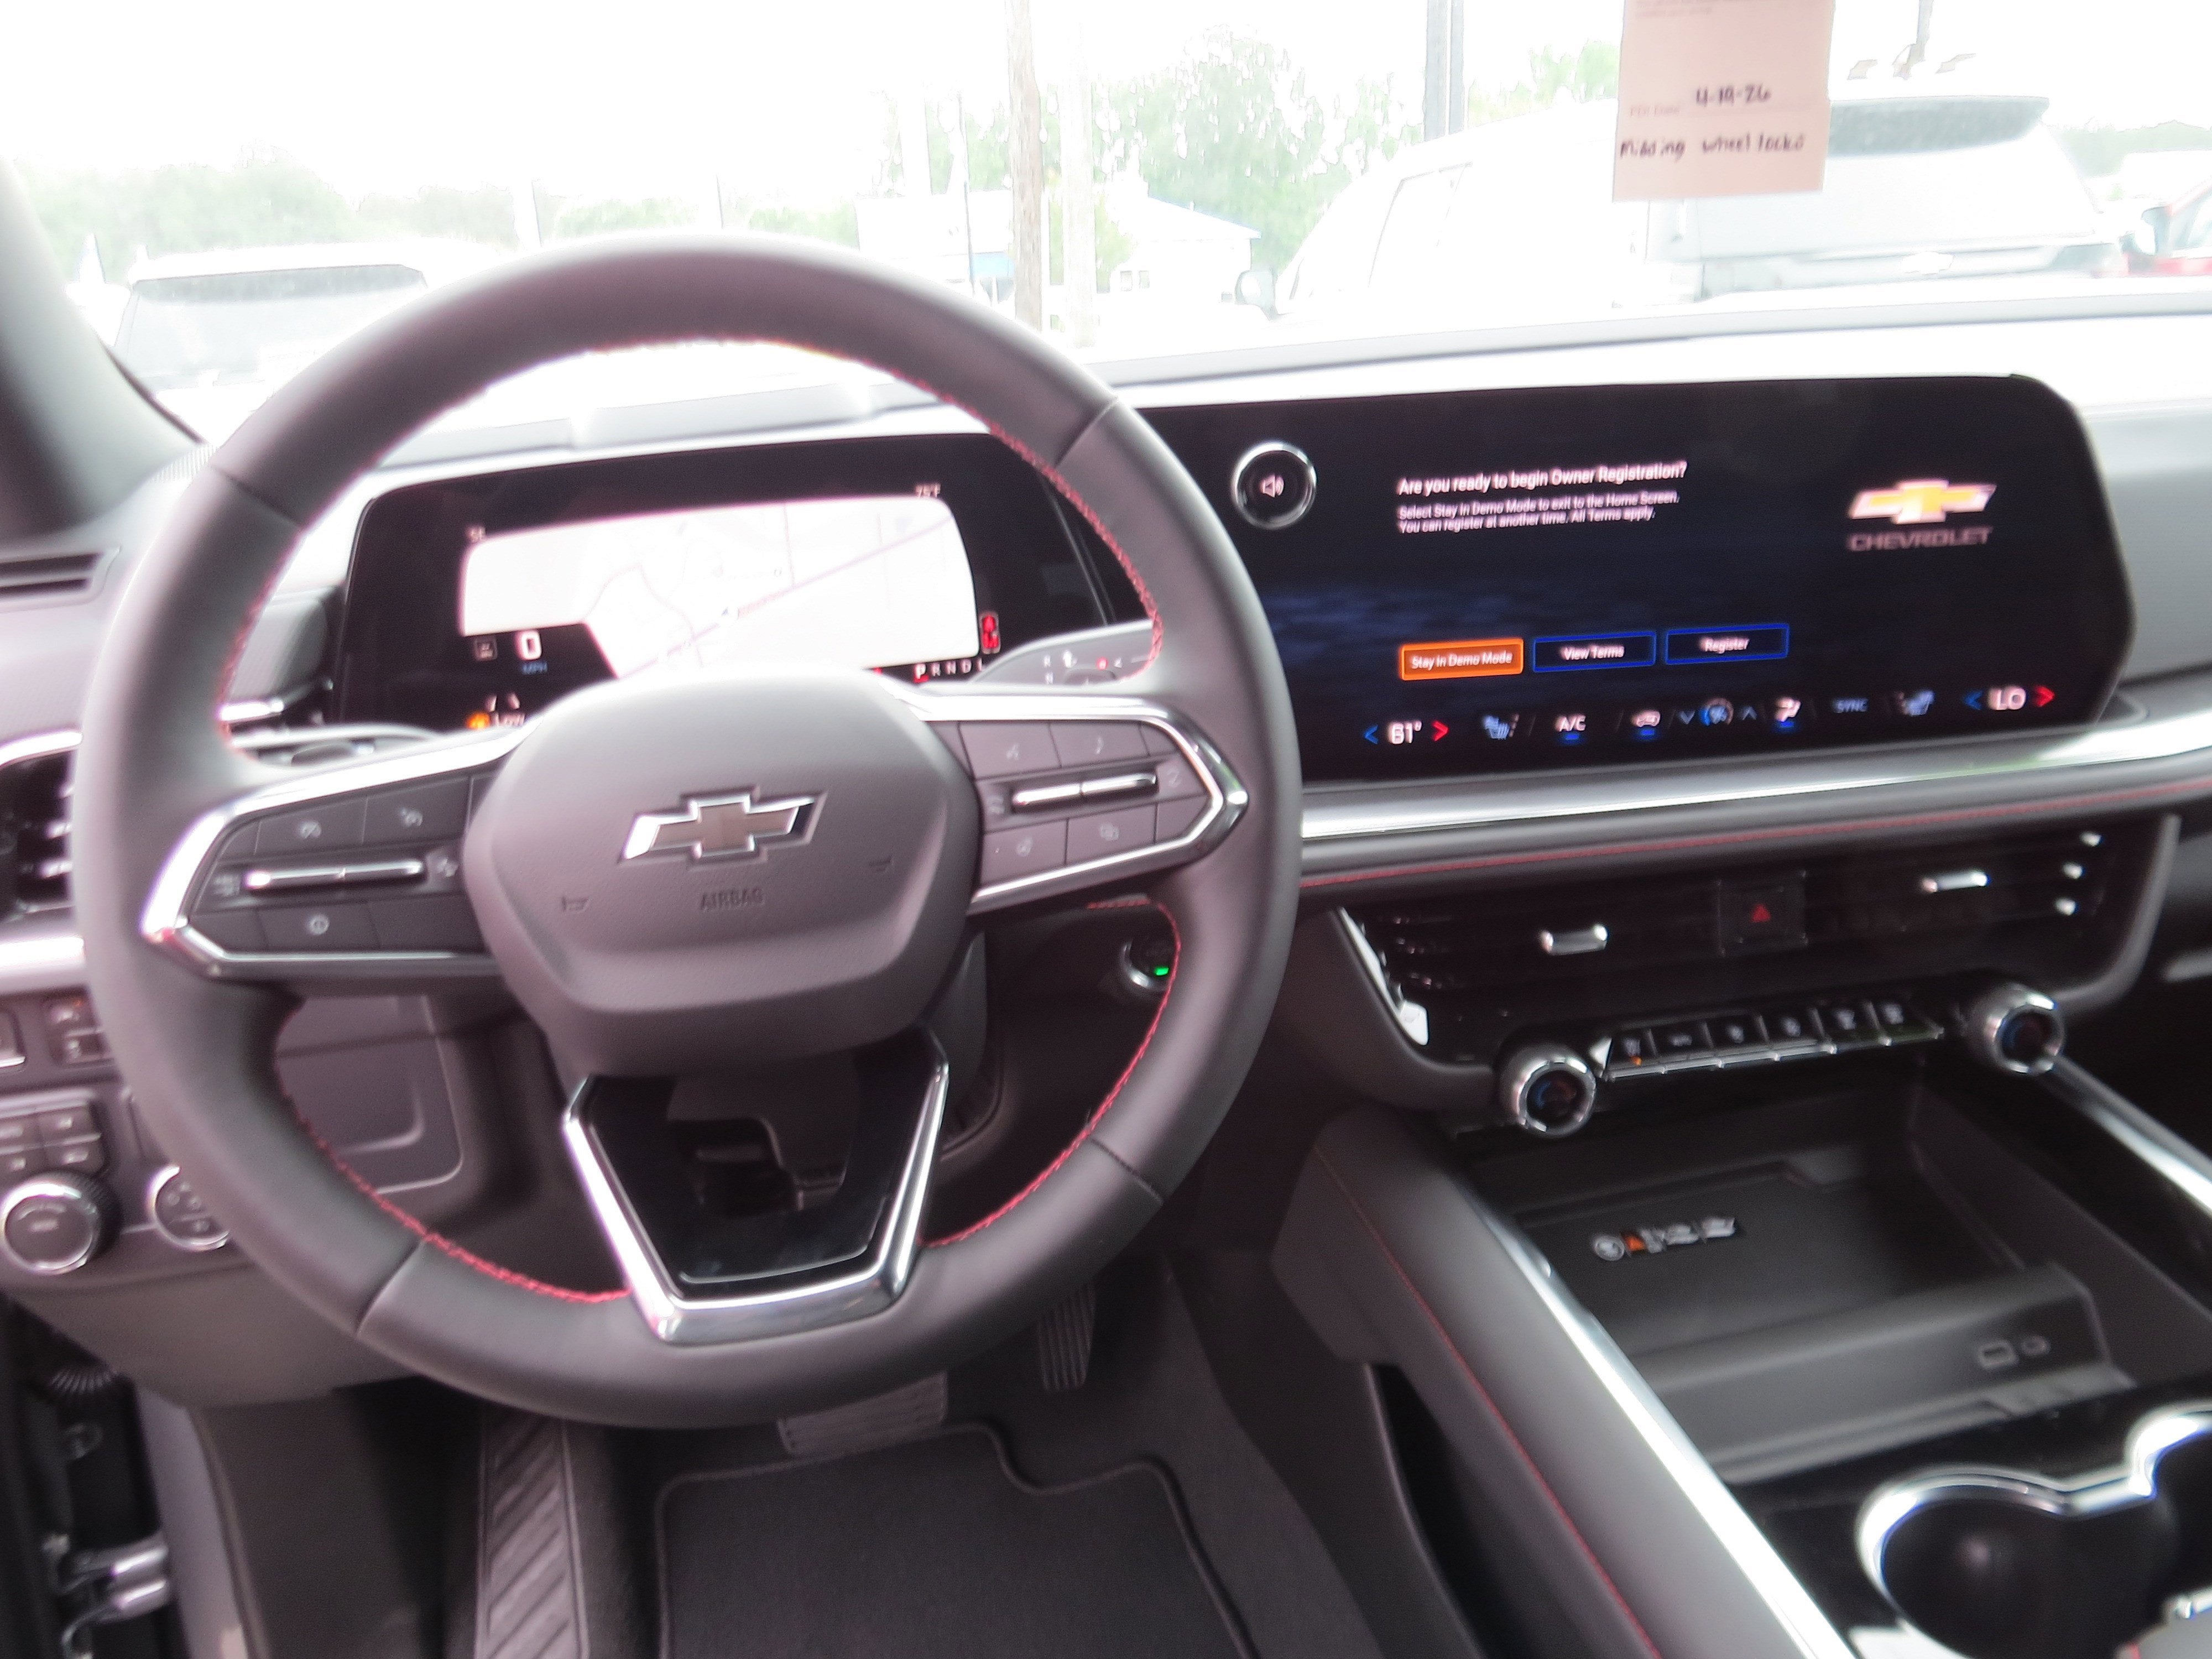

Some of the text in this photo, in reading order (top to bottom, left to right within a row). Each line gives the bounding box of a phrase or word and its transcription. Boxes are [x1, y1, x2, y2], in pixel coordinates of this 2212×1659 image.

[1396, 460, 1687, 497] Are you ready to begin Owner Registration?
[1397, 504, 1432, 520] Select
[1432, 503, 1458, 519] Stay
[1470, 499, 1504, 515] Demo
[1505, 497, 1537, 513] Mode
[1537, 498, 1549, 512] to
[1585, 493, 1604, 508] the
[1605, 492, 1639, 507] Home
[1397, 519, 1421, 534] You
[1562, 644, 1625, 660] View Terms
[1699, 637, 1750, 654] Register
[1411, 654, 1436, 670] Stay
[1448, 653, 1480, 667] Demo
[1481, 650, 1514, 665] Mode
[1987, 686, 2027, 711] LO
[1555, 715, 1587, 732] A/C
